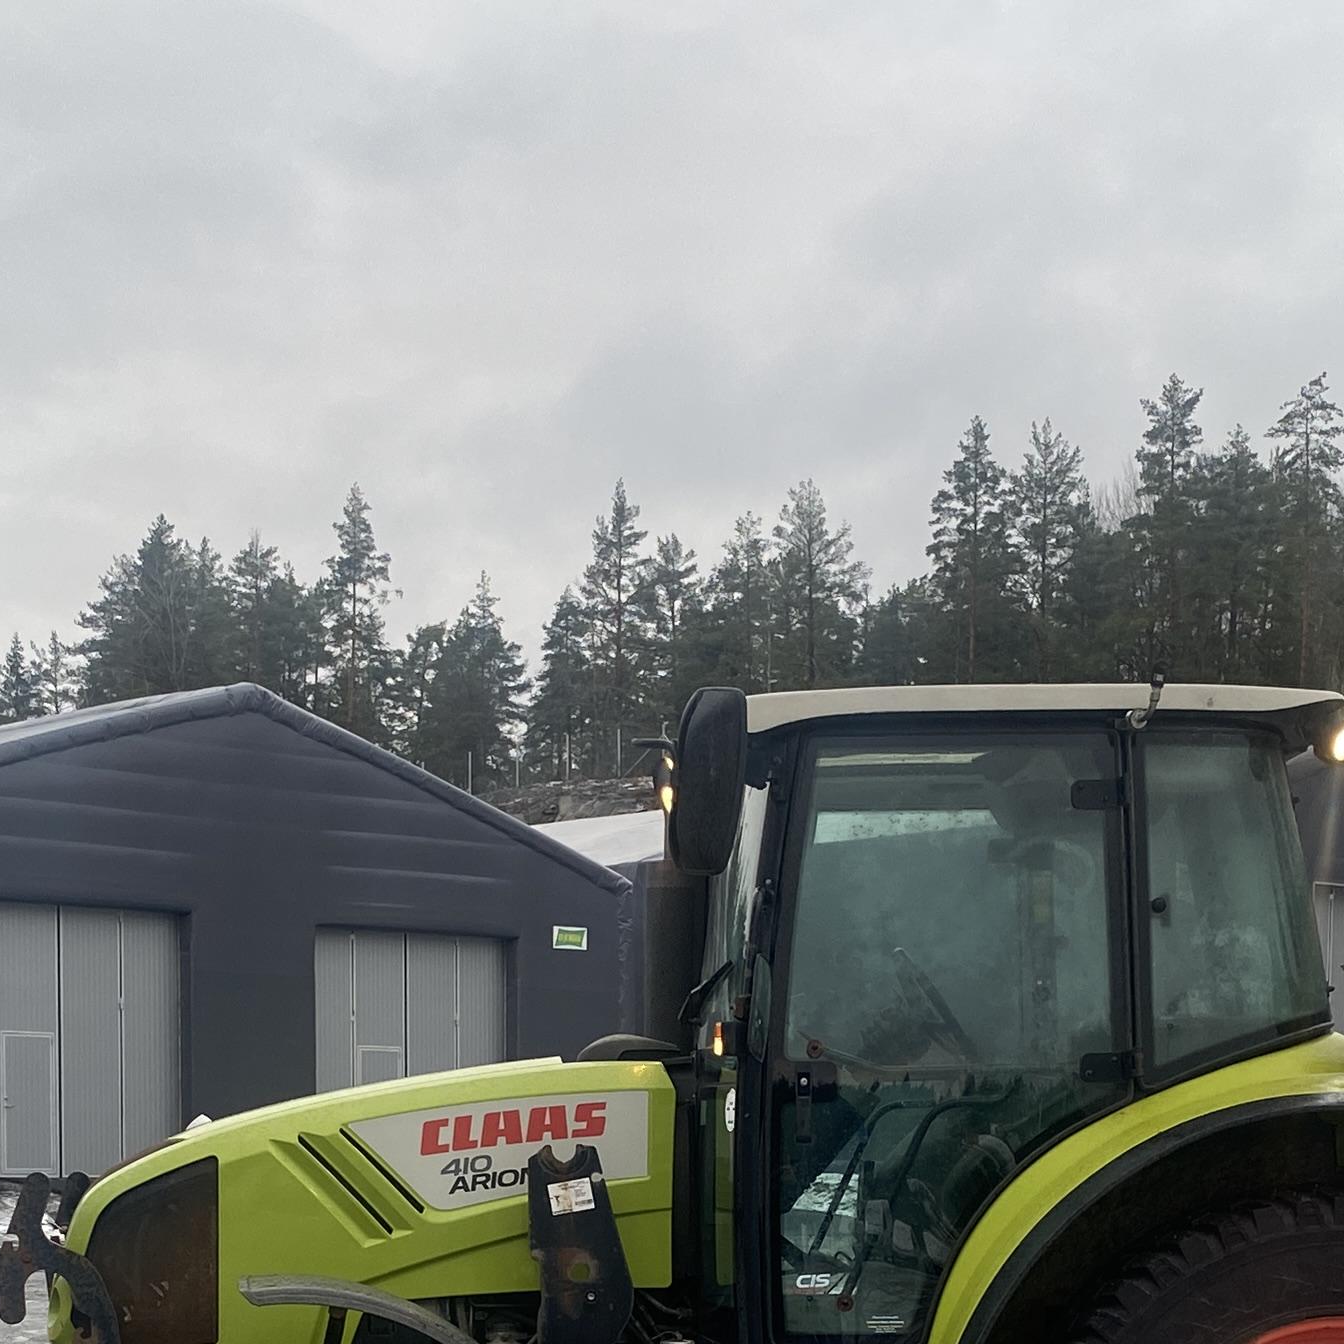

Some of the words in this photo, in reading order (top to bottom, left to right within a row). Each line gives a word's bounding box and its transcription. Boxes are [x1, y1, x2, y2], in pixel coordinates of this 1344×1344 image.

[420, 1102, 607, 1155] CLAAS
[440, 1154, 493, 1176] 410
[795, 1273, 831, 1289] CIS
